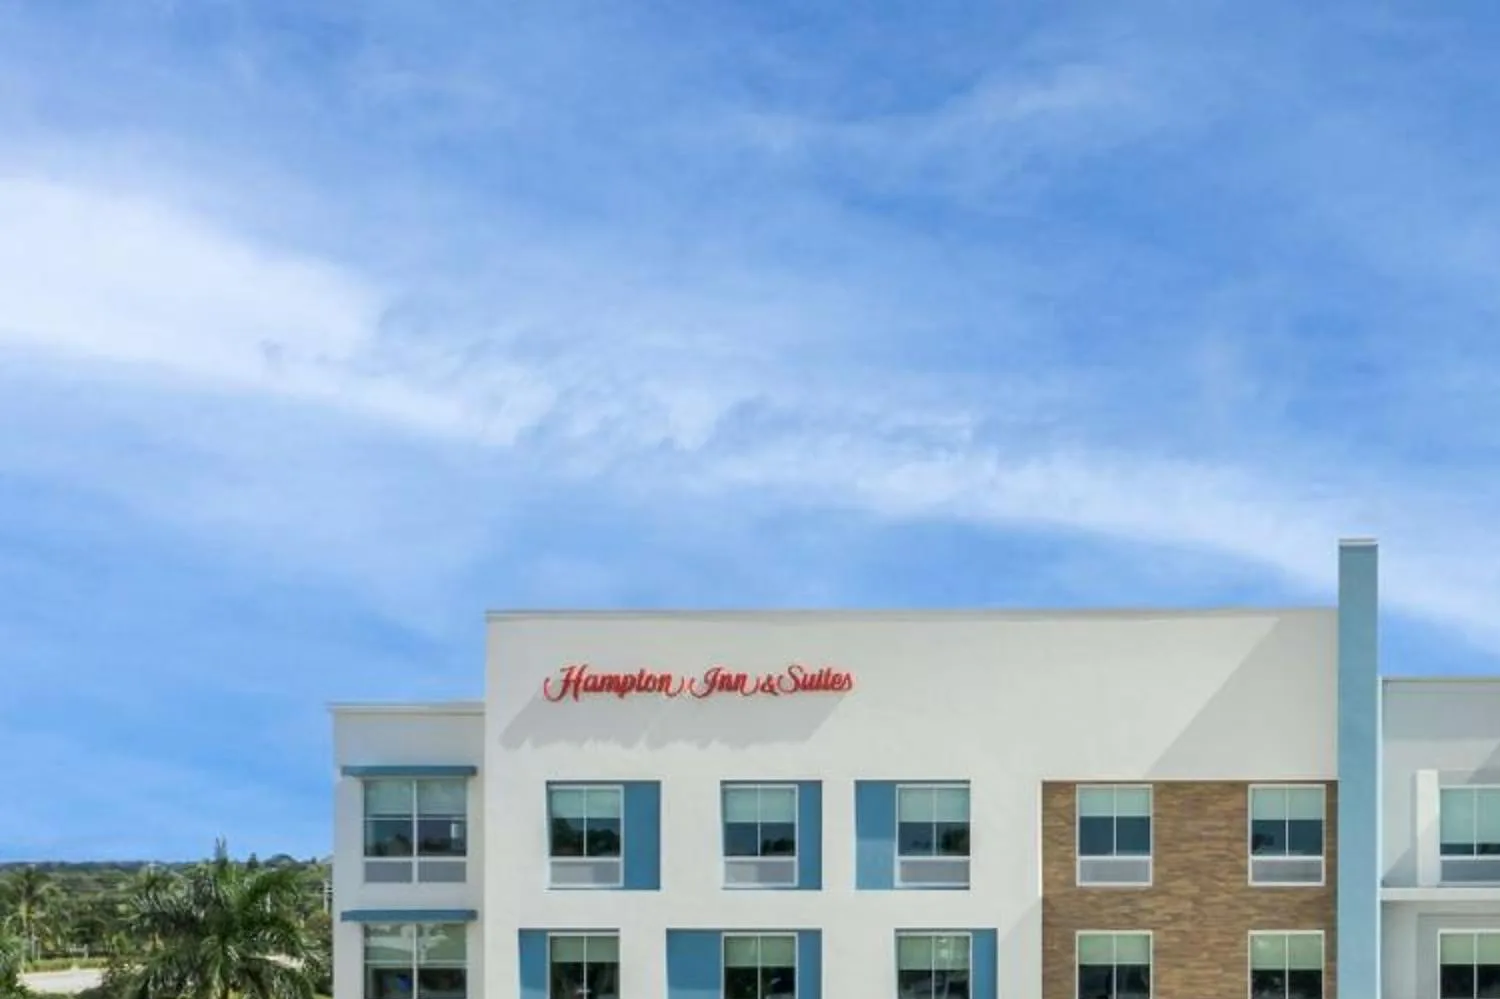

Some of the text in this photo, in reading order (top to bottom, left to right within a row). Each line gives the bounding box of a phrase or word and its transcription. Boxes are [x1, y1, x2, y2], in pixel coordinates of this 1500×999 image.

[544, 664, 854, 701] Hampton Inn & Suites
